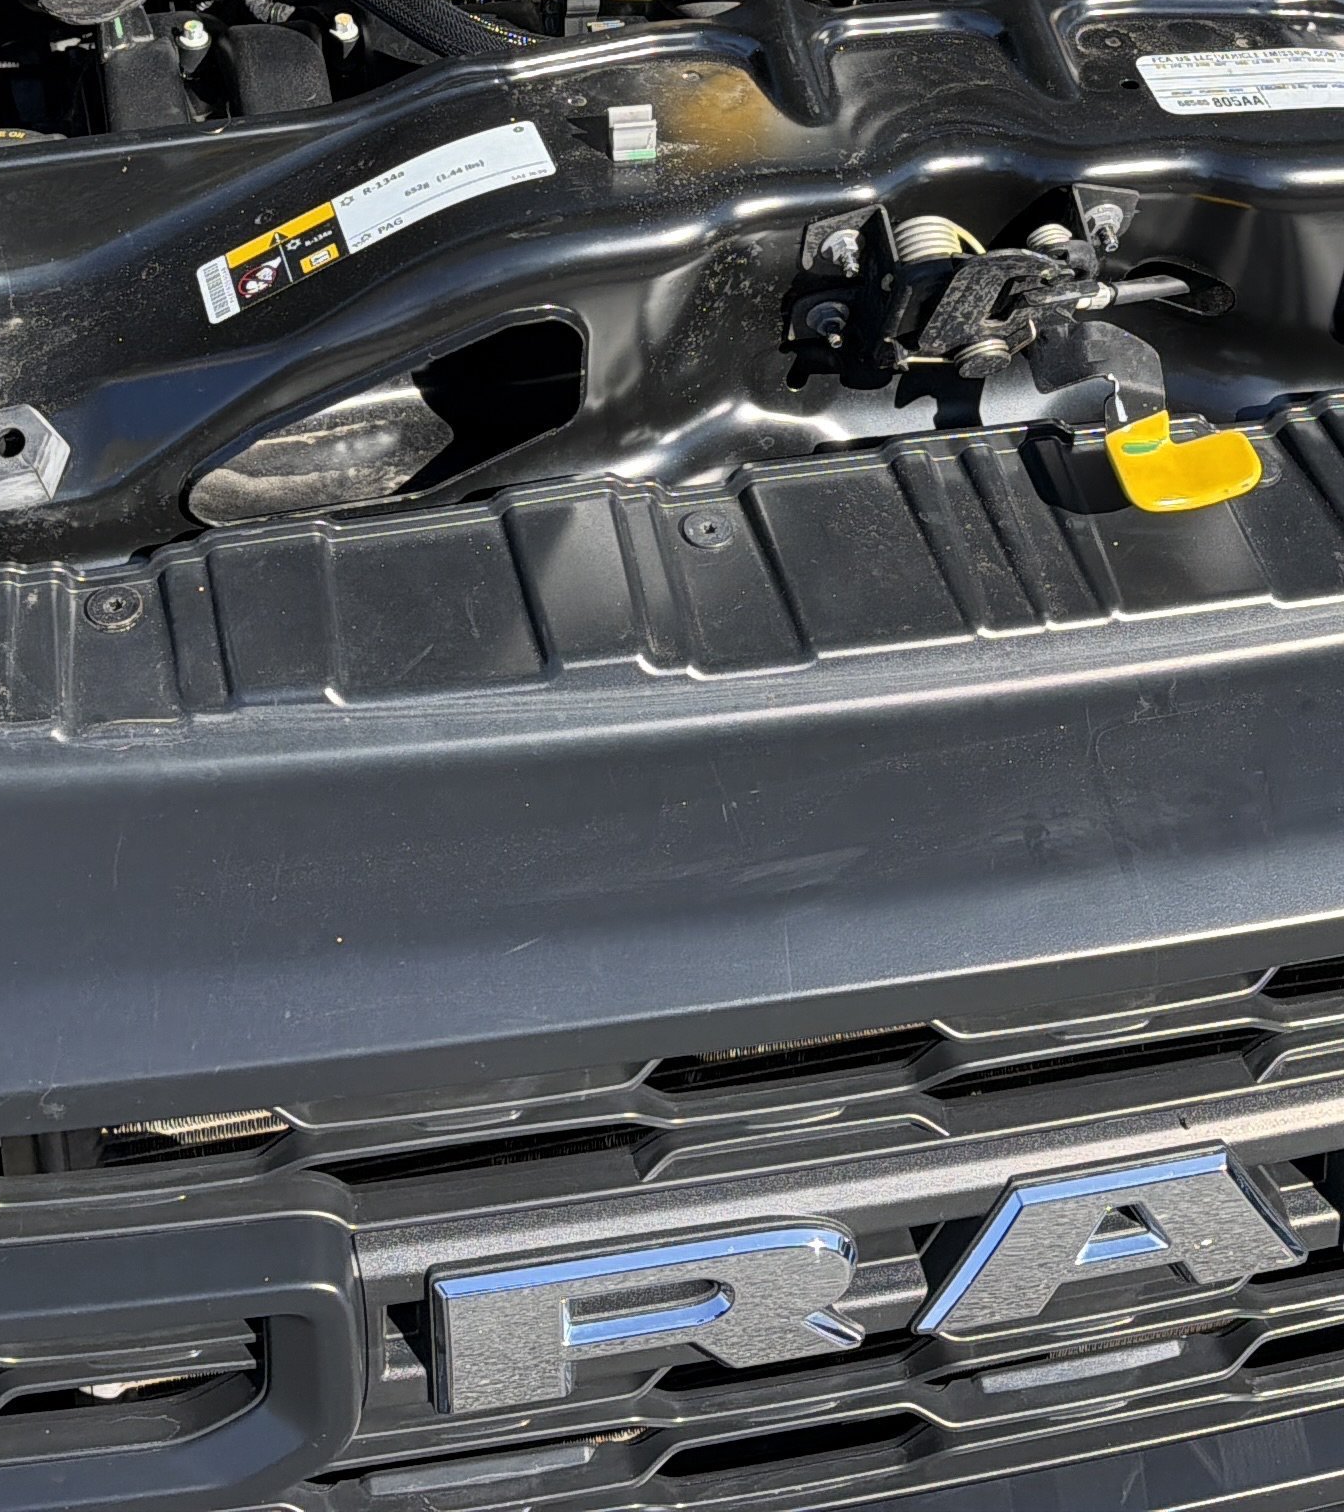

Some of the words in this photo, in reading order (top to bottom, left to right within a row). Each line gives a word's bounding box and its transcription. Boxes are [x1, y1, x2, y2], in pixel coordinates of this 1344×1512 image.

[1211, 95, 1265, 108] 805AA
[362, 170, 406, 197] R-134a
[377, 217, 405, 235] PAG
